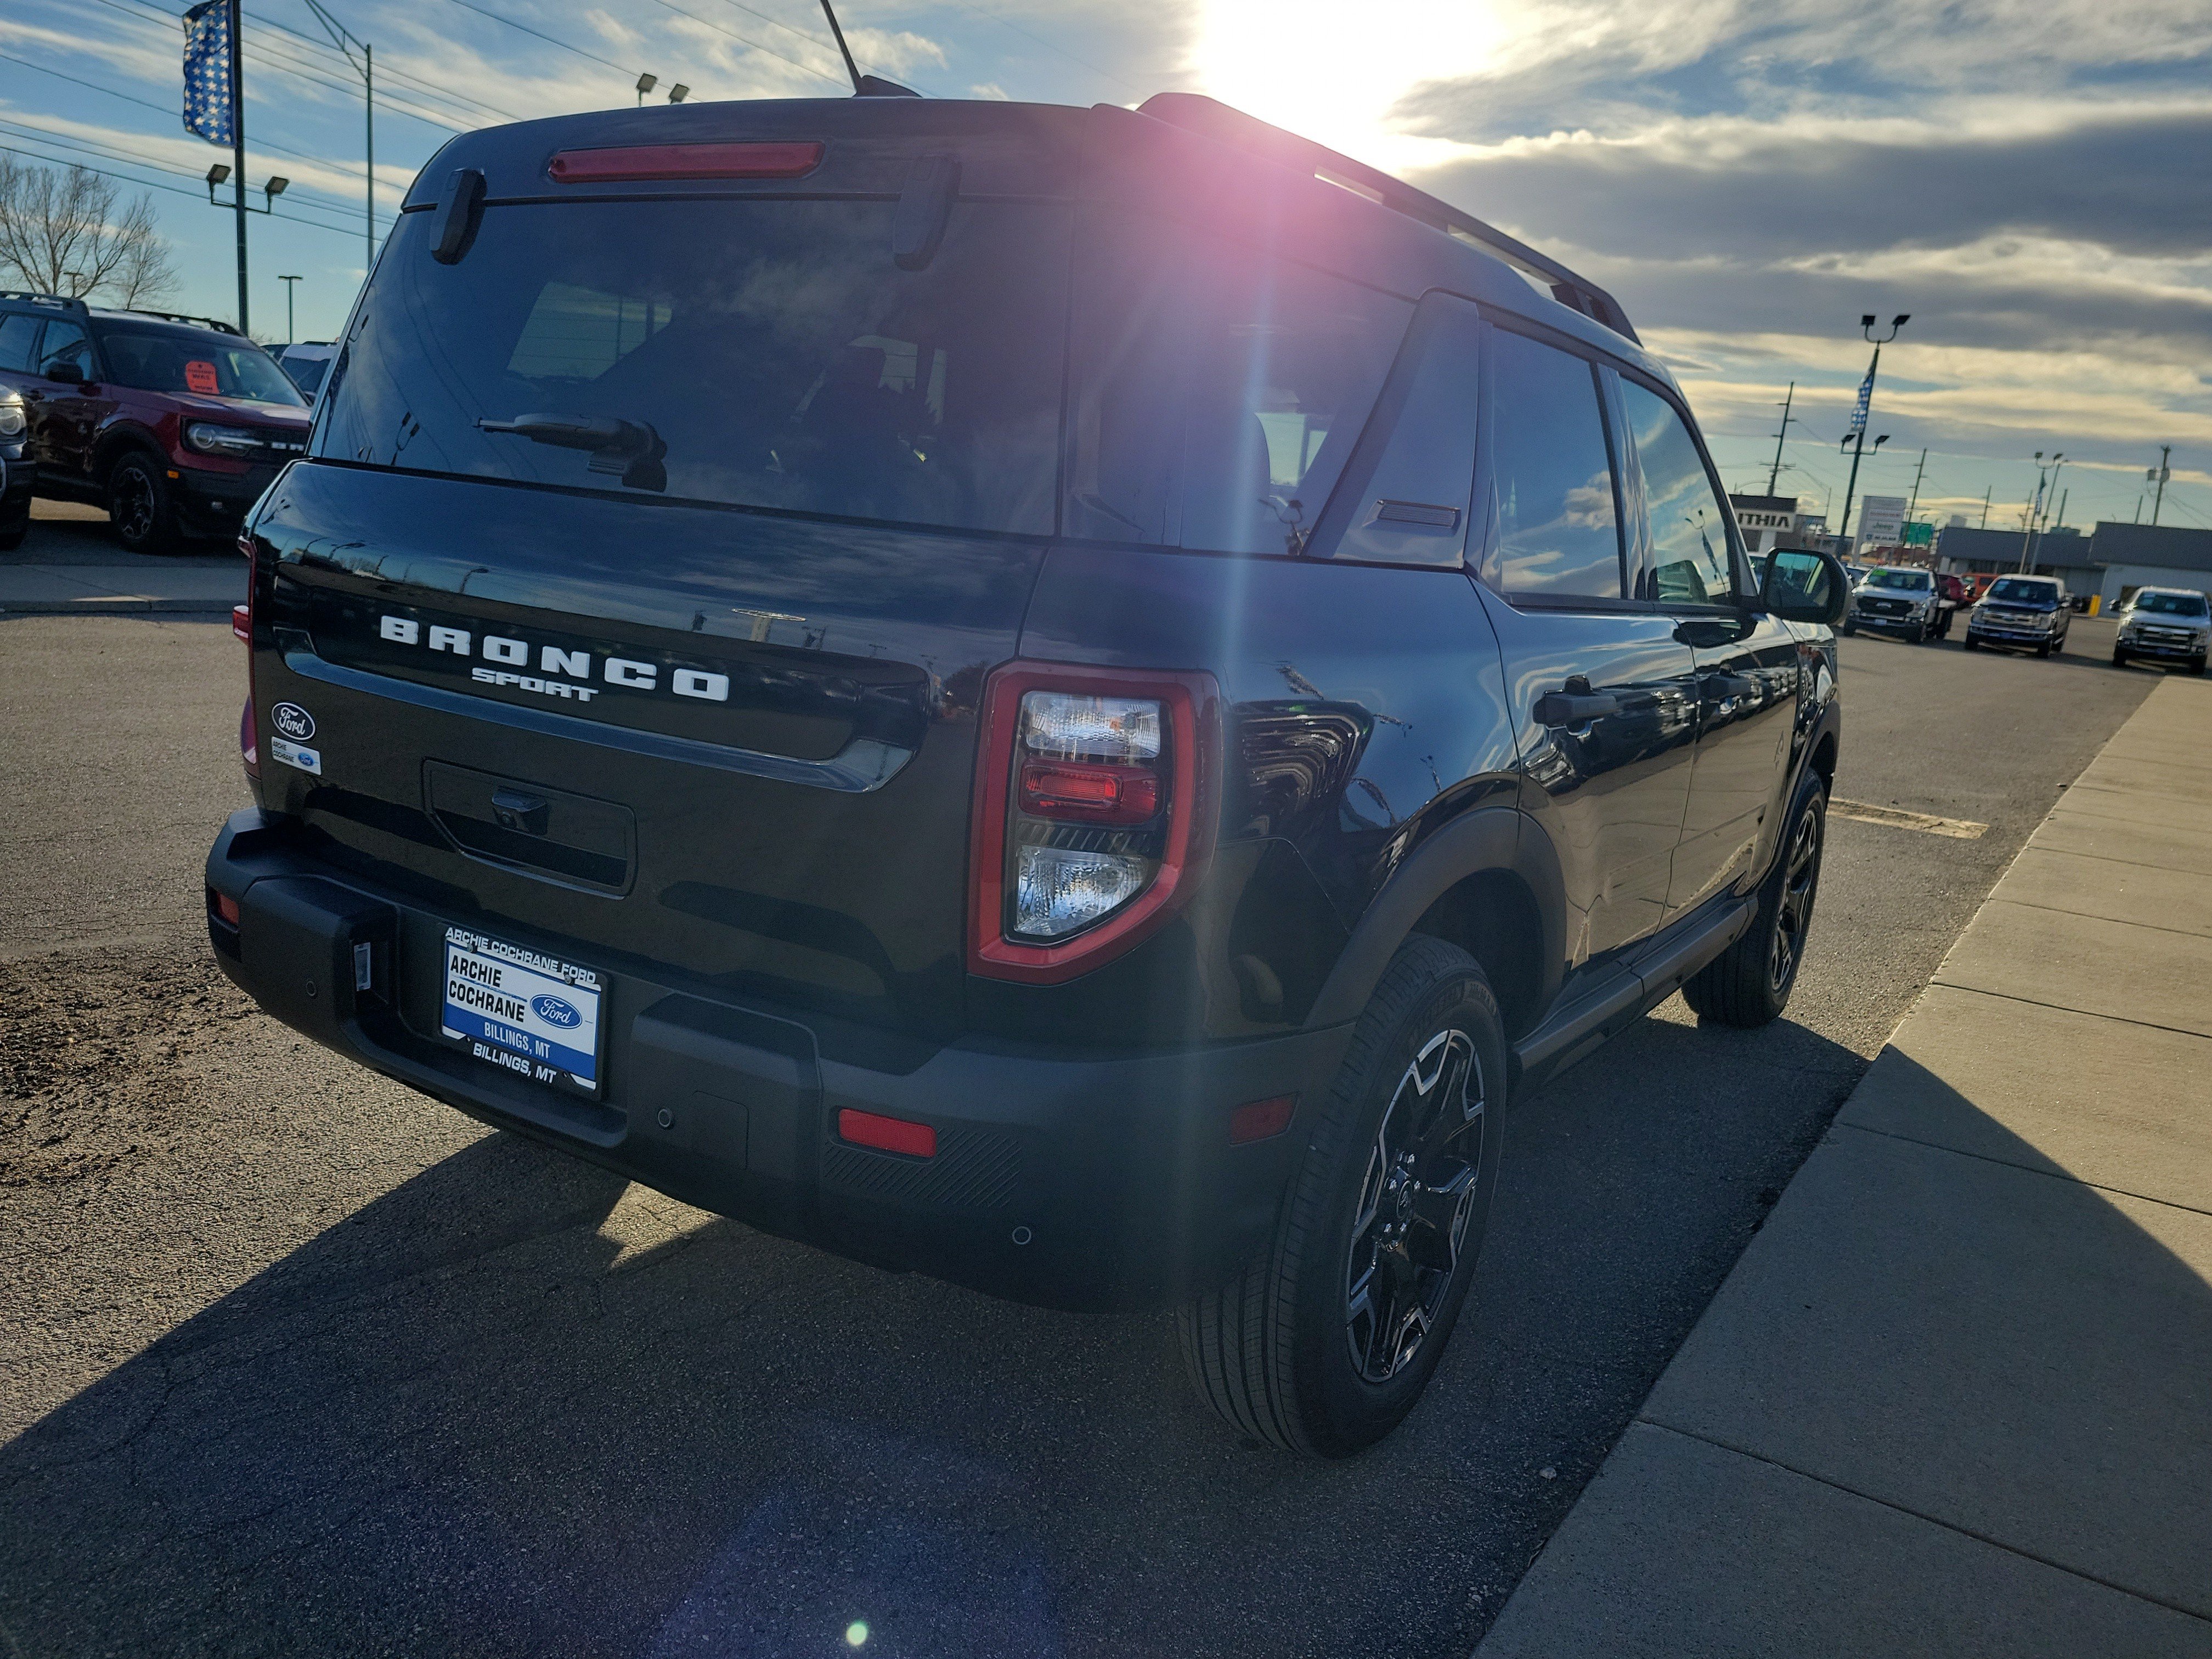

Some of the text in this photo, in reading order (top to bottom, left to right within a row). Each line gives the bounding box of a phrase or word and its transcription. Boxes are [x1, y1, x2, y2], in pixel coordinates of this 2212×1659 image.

[1737, 512, 1790, 528] ITHIA
[380, 615, 730, 702] BRONCO
[472, 667, 599, 702] SPORT
[278, 706, 307, 736] Ford
[445, 927, 596, 984] ARCHIE COCHRANE FORD
[450, 955, 503, 988] ARCHIE
[449, 980, 525, 1023] COCHRANE
[539, 997, 572, 1024] Ford
[484, 1022, 550, 1059] BILLINGS, MT
[473, 1043, 556, 1084] BILLINGS, MT
